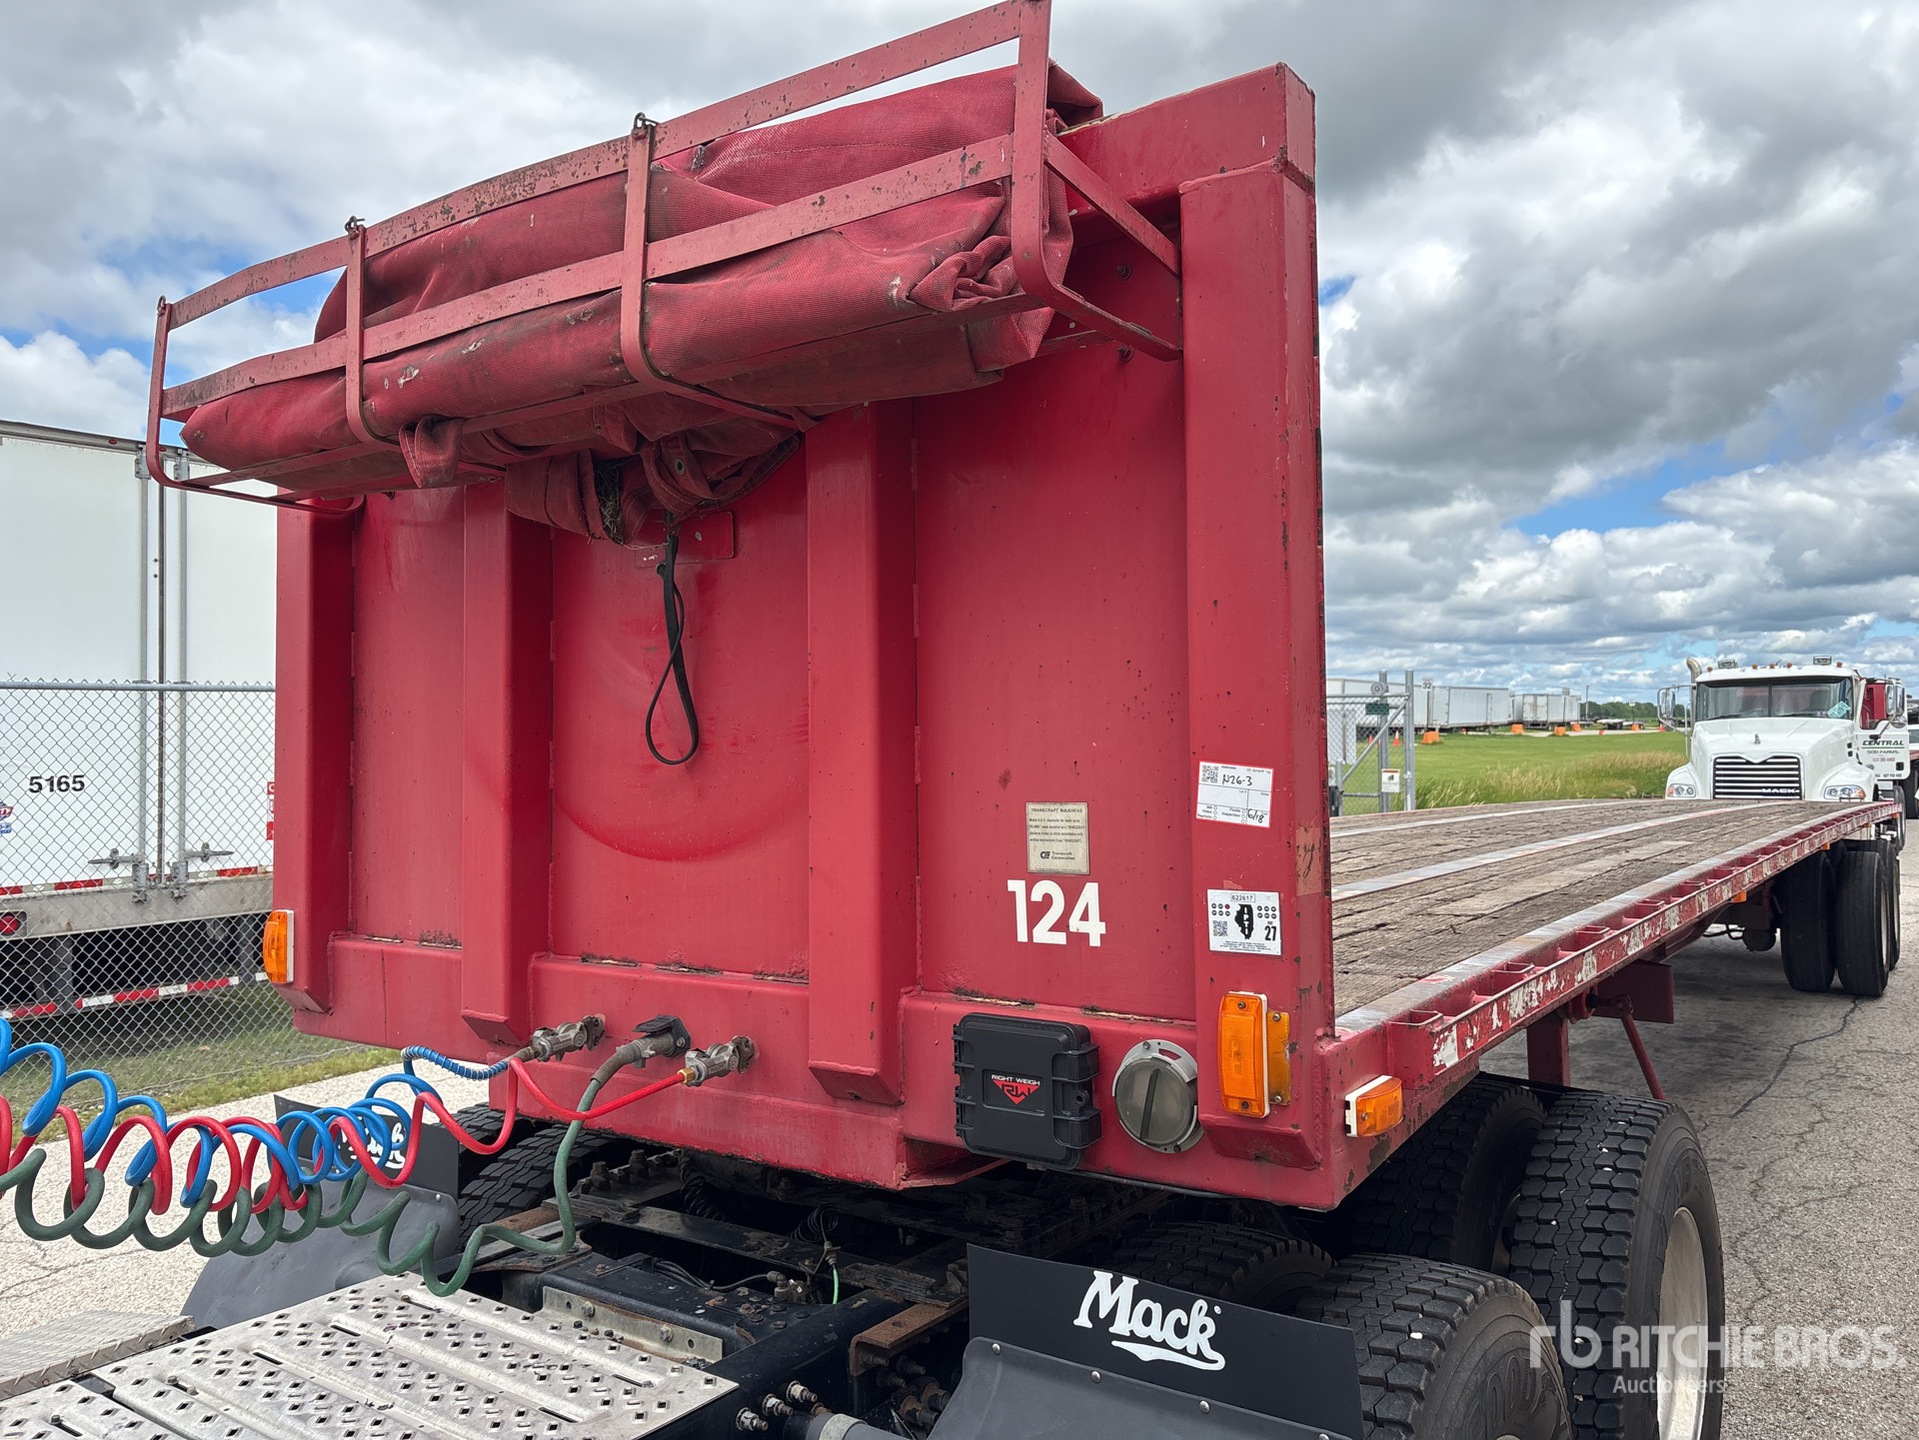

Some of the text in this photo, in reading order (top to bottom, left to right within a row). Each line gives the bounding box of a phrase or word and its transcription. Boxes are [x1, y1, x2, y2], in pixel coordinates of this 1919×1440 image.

[28, 774, 85, 793] 5165
[1007, 879, 1106, 947] 124
[1264, 925, 1277, 941] 27
[991, 1074, 1040, 1086] RIGHT WEIGH
[1073, 1270, 1226, 1371] Mack
